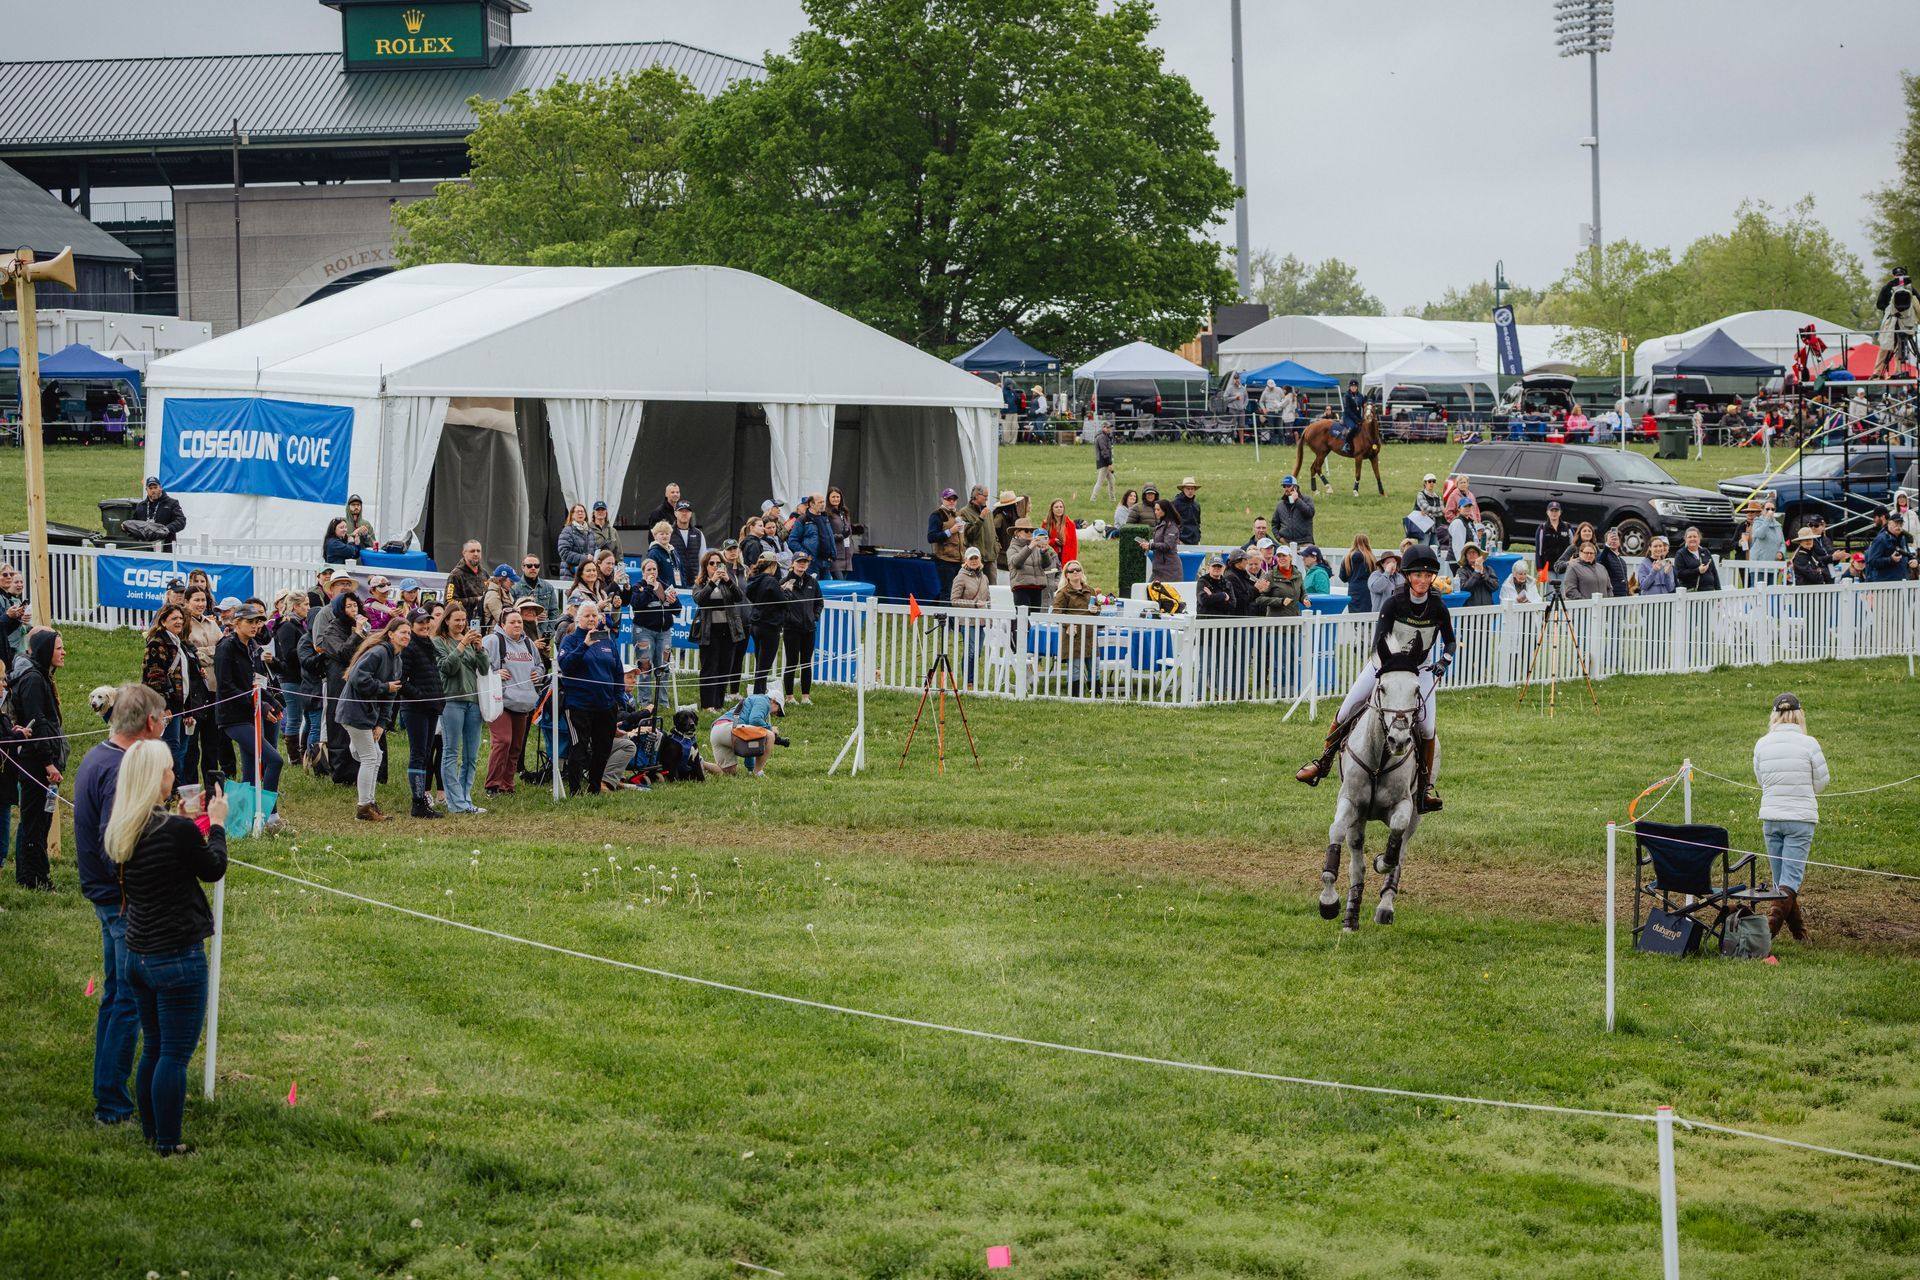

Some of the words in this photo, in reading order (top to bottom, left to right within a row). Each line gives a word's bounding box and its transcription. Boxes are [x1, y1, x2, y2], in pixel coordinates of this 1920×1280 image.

[375, 37, 455, 55] ROLEX
[323, 247, 385, 278] ROLEX
[178, 429, 280, 462] COSEQUIN
[285, 434, 332, 468] COVE
[126, 589, 144, 600] Joint
[144, 591, 166, 601] Healt
[620, 623, 633, 634] Joi
[670, 628, 690, 640] Supp
[1653, 923, 1675, 940] dubarry
